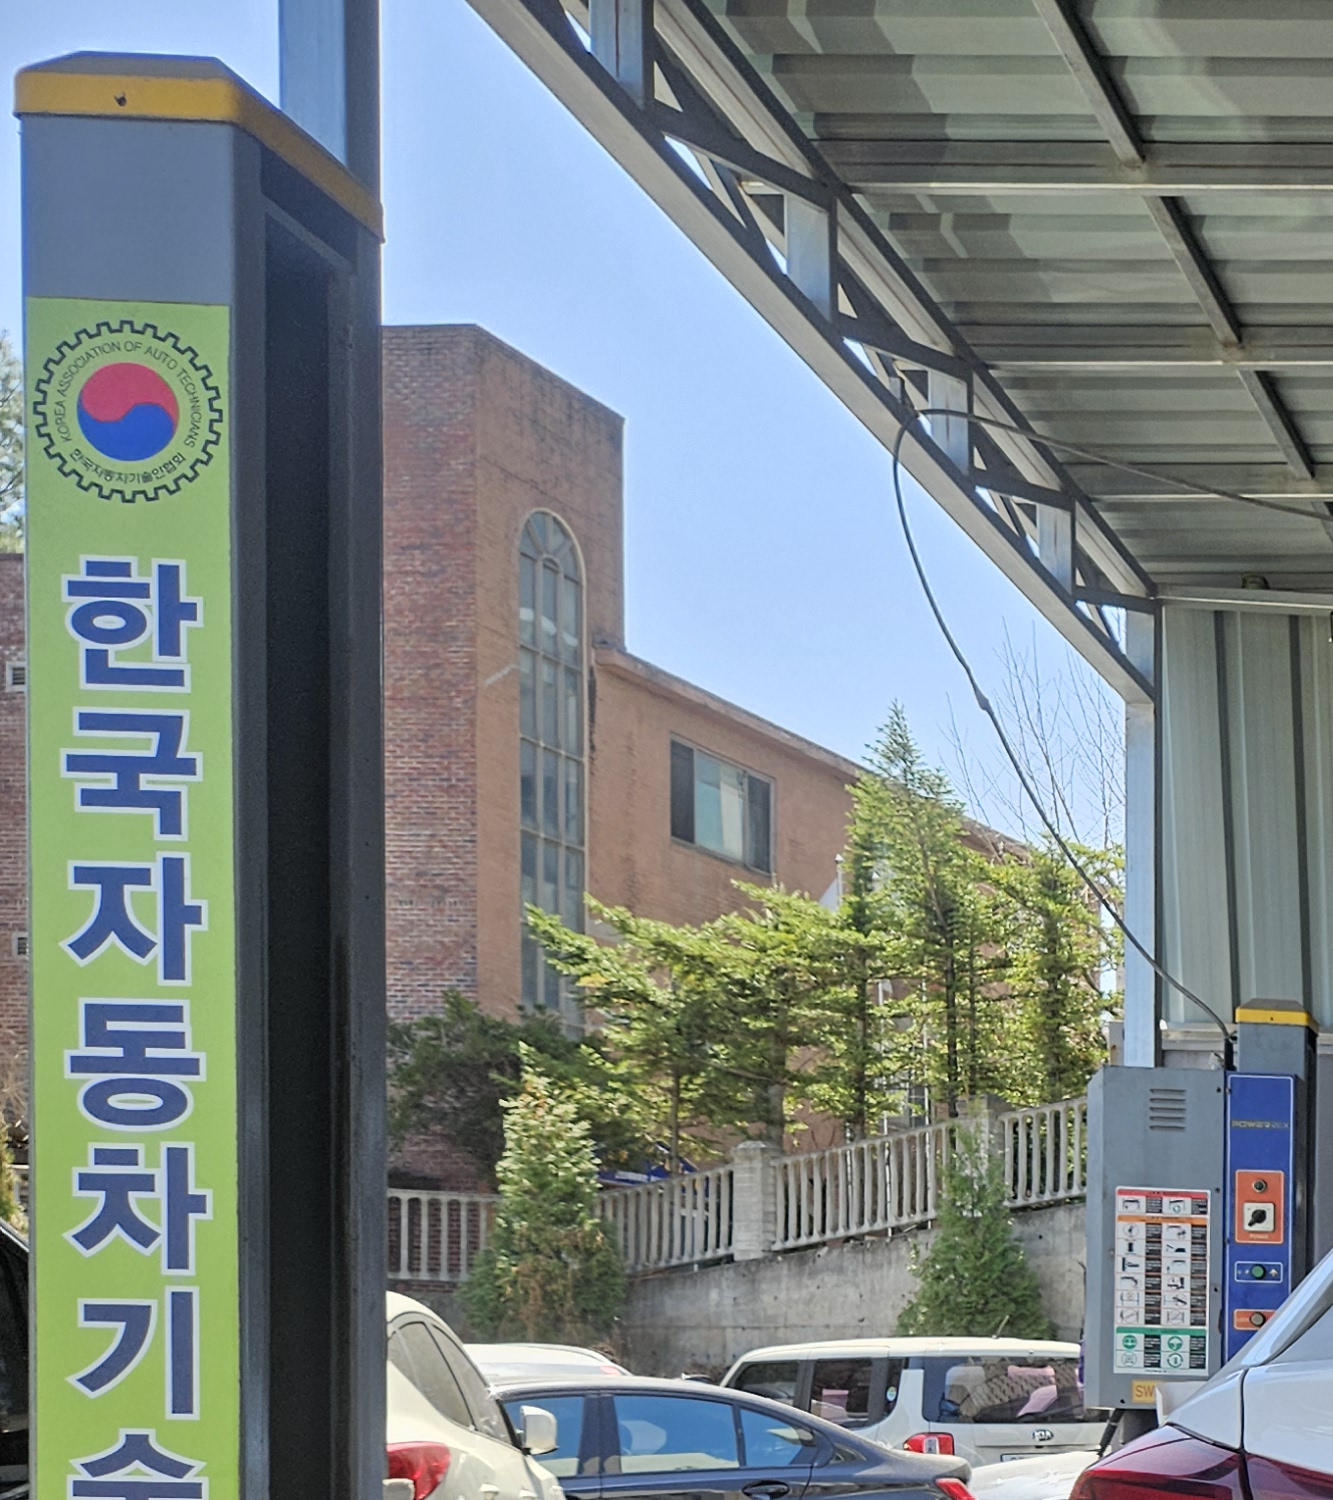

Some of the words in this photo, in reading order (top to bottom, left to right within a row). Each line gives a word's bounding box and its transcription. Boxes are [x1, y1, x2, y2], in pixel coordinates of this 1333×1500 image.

[124, 340, 142, 352] OF
[145, 346, 178, 371] AUTO
[57, 341, 121, 398] ASSOCIATION
[54, 400, 73, 443] KOREA
[176, 368, 203, 449] TECHNICIANS
